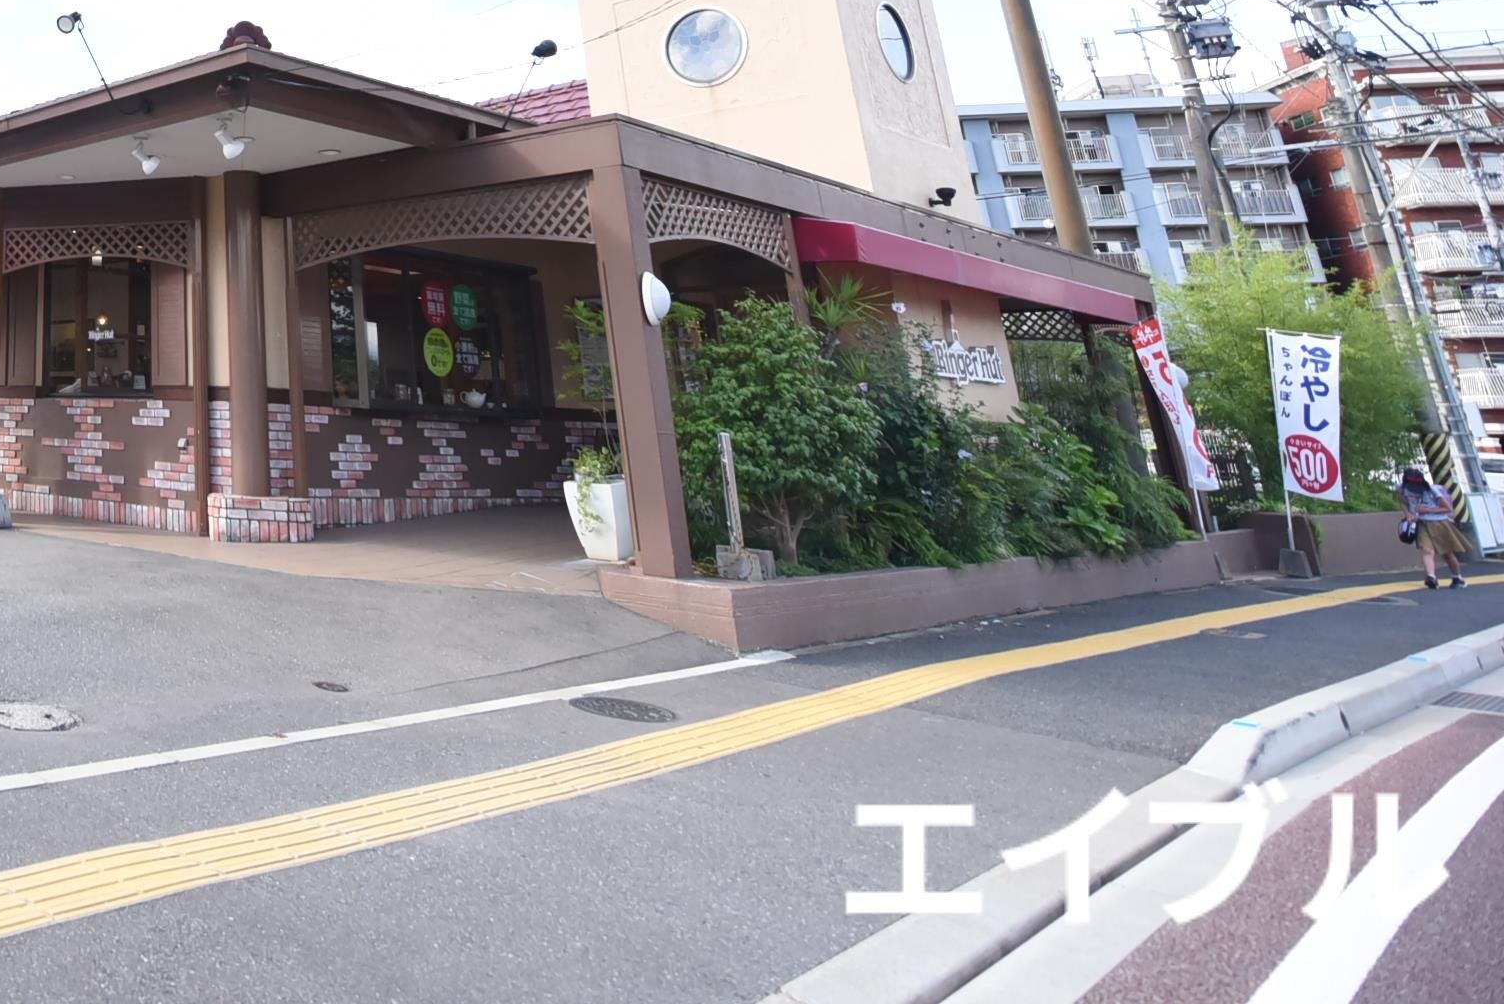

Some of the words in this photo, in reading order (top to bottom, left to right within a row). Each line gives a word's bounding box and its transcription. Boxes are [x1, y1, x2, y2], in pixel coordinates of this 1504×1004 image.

[934, 342, 978, 382] Ringer
[977, 349, 1004, 381] Hut
[1280, 347, 1293, 418] ちゃんぽん
[1300, 344, 1332, 432] 冷やし
[1288, 445, 1328, 484] 500
